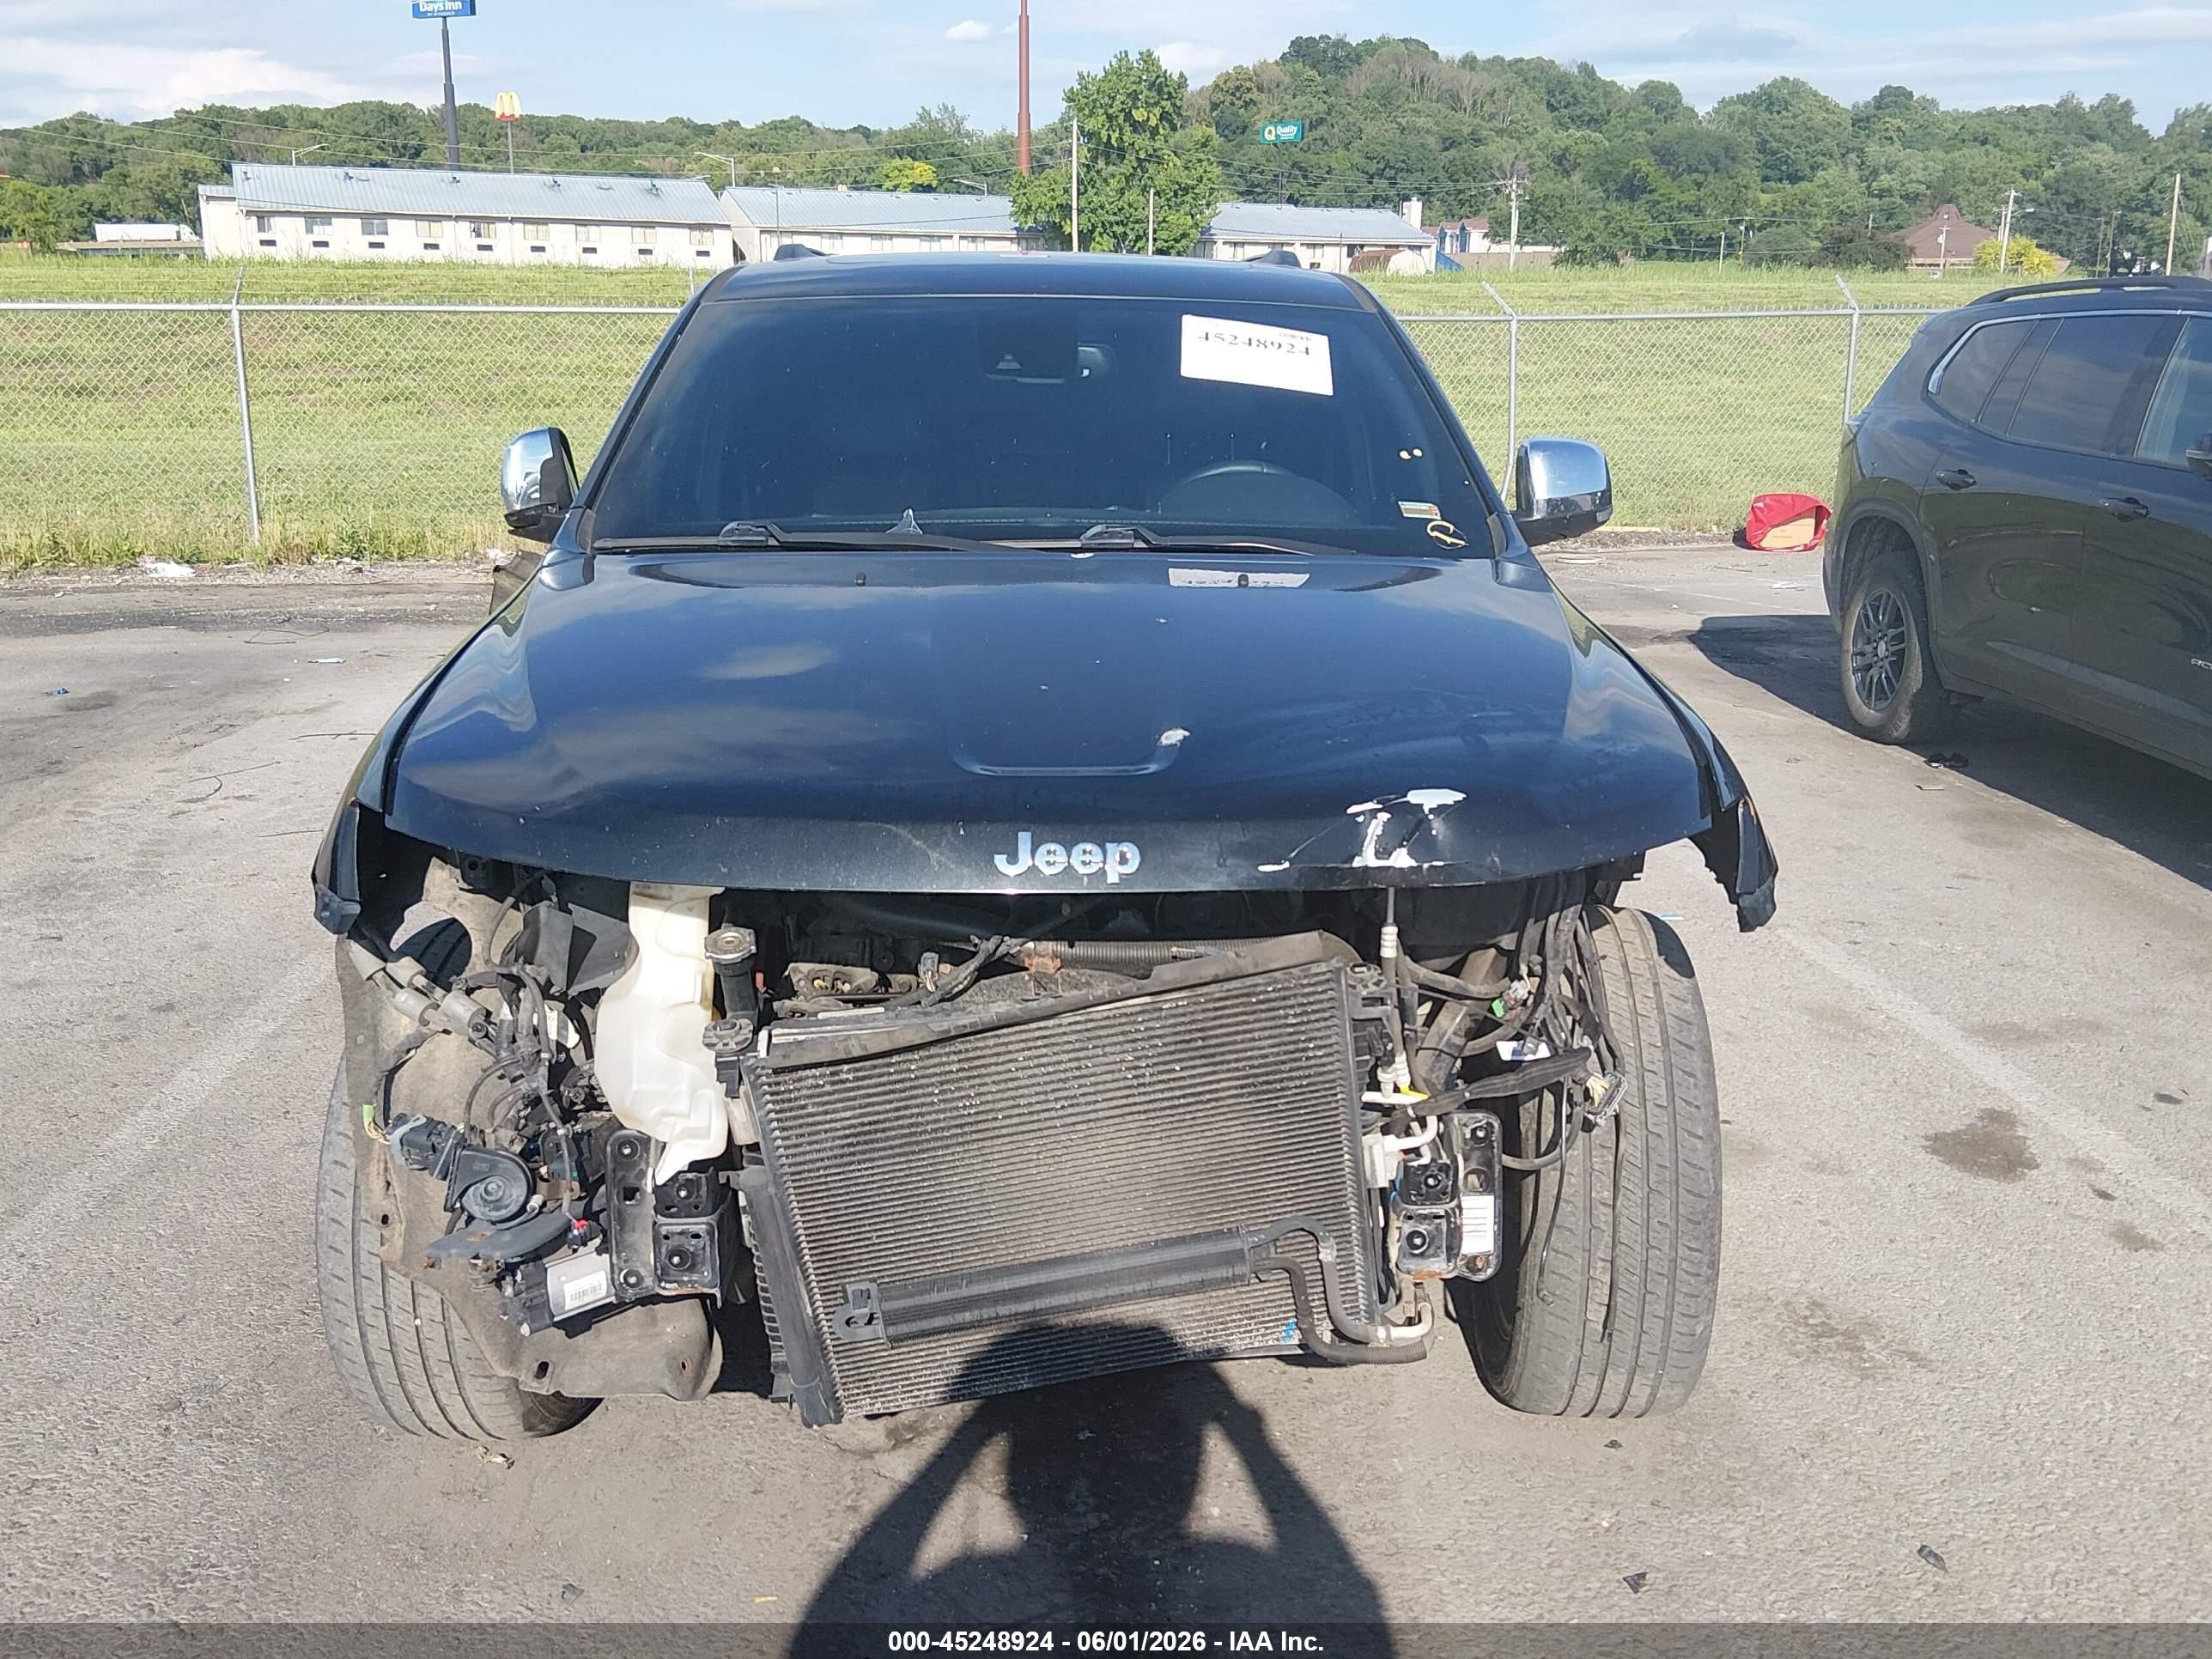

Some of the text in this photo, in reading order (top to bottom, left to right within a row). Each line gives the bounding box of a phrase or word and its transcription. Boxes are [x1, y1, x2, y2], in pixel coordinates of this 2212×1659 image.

[419, 1, 462, 12] Days Inn
[1198, 331, 1310, 356] 45248924
[994, 831, 1141, 884] Jeep
